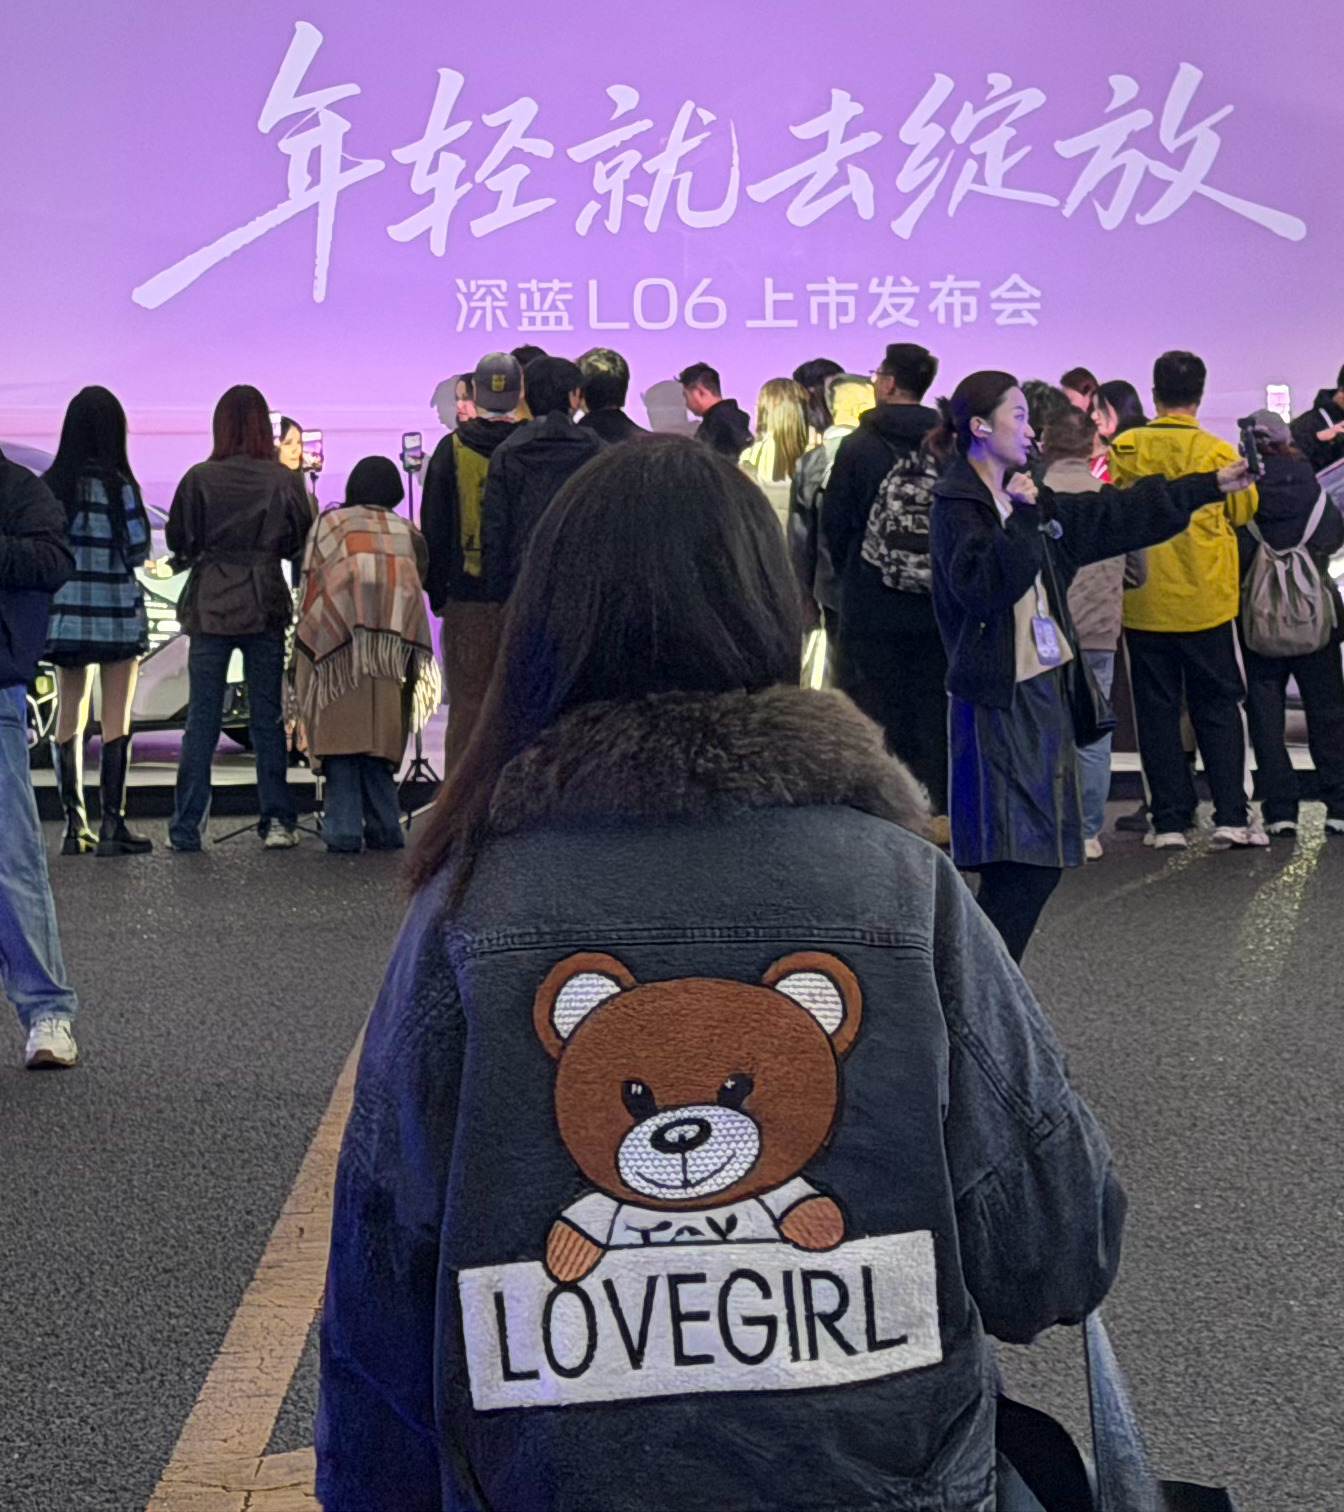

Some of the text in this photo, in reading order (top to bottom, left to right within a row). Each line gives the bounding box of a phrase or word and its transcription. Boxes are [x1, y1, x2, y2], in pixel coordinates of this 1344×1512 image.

[131, 20, 1307, 309] 年轻就去绽放
[493, 1264, 908, 1382] LOVEGIRL
